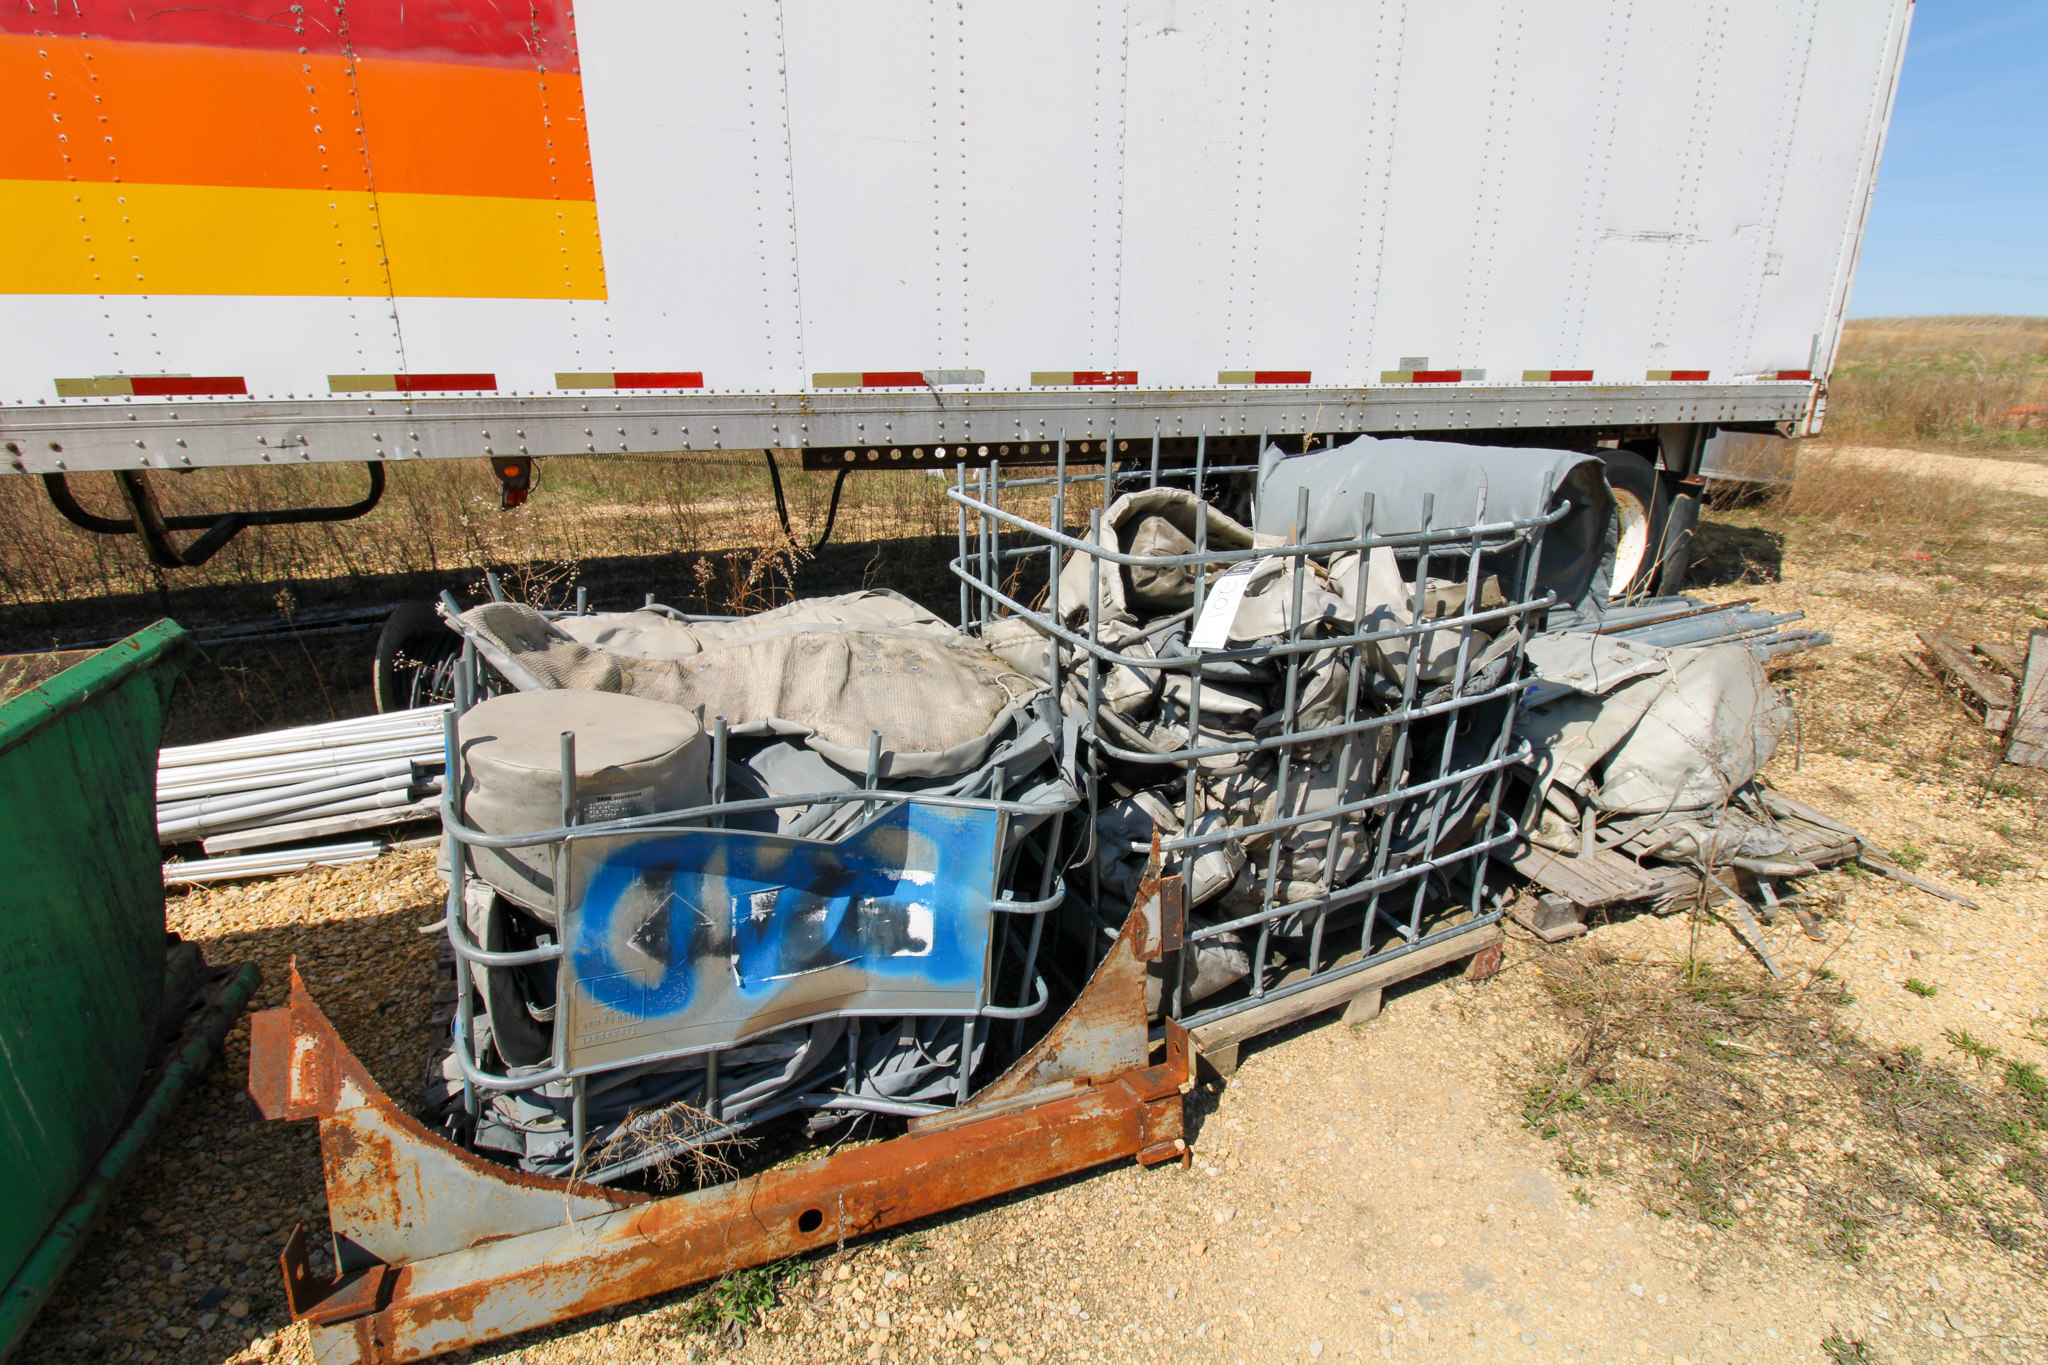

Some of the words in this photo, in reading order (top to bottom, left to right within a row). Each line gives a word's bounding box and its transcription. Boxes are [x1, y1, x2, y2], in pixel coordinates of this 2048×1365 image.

[613, 792, 642, 801] DIVISION
[581, 1019, 601, 1029] max
[604, 1015, 615, 1025] kg
[581, 1026, 638, 1045] Transport
